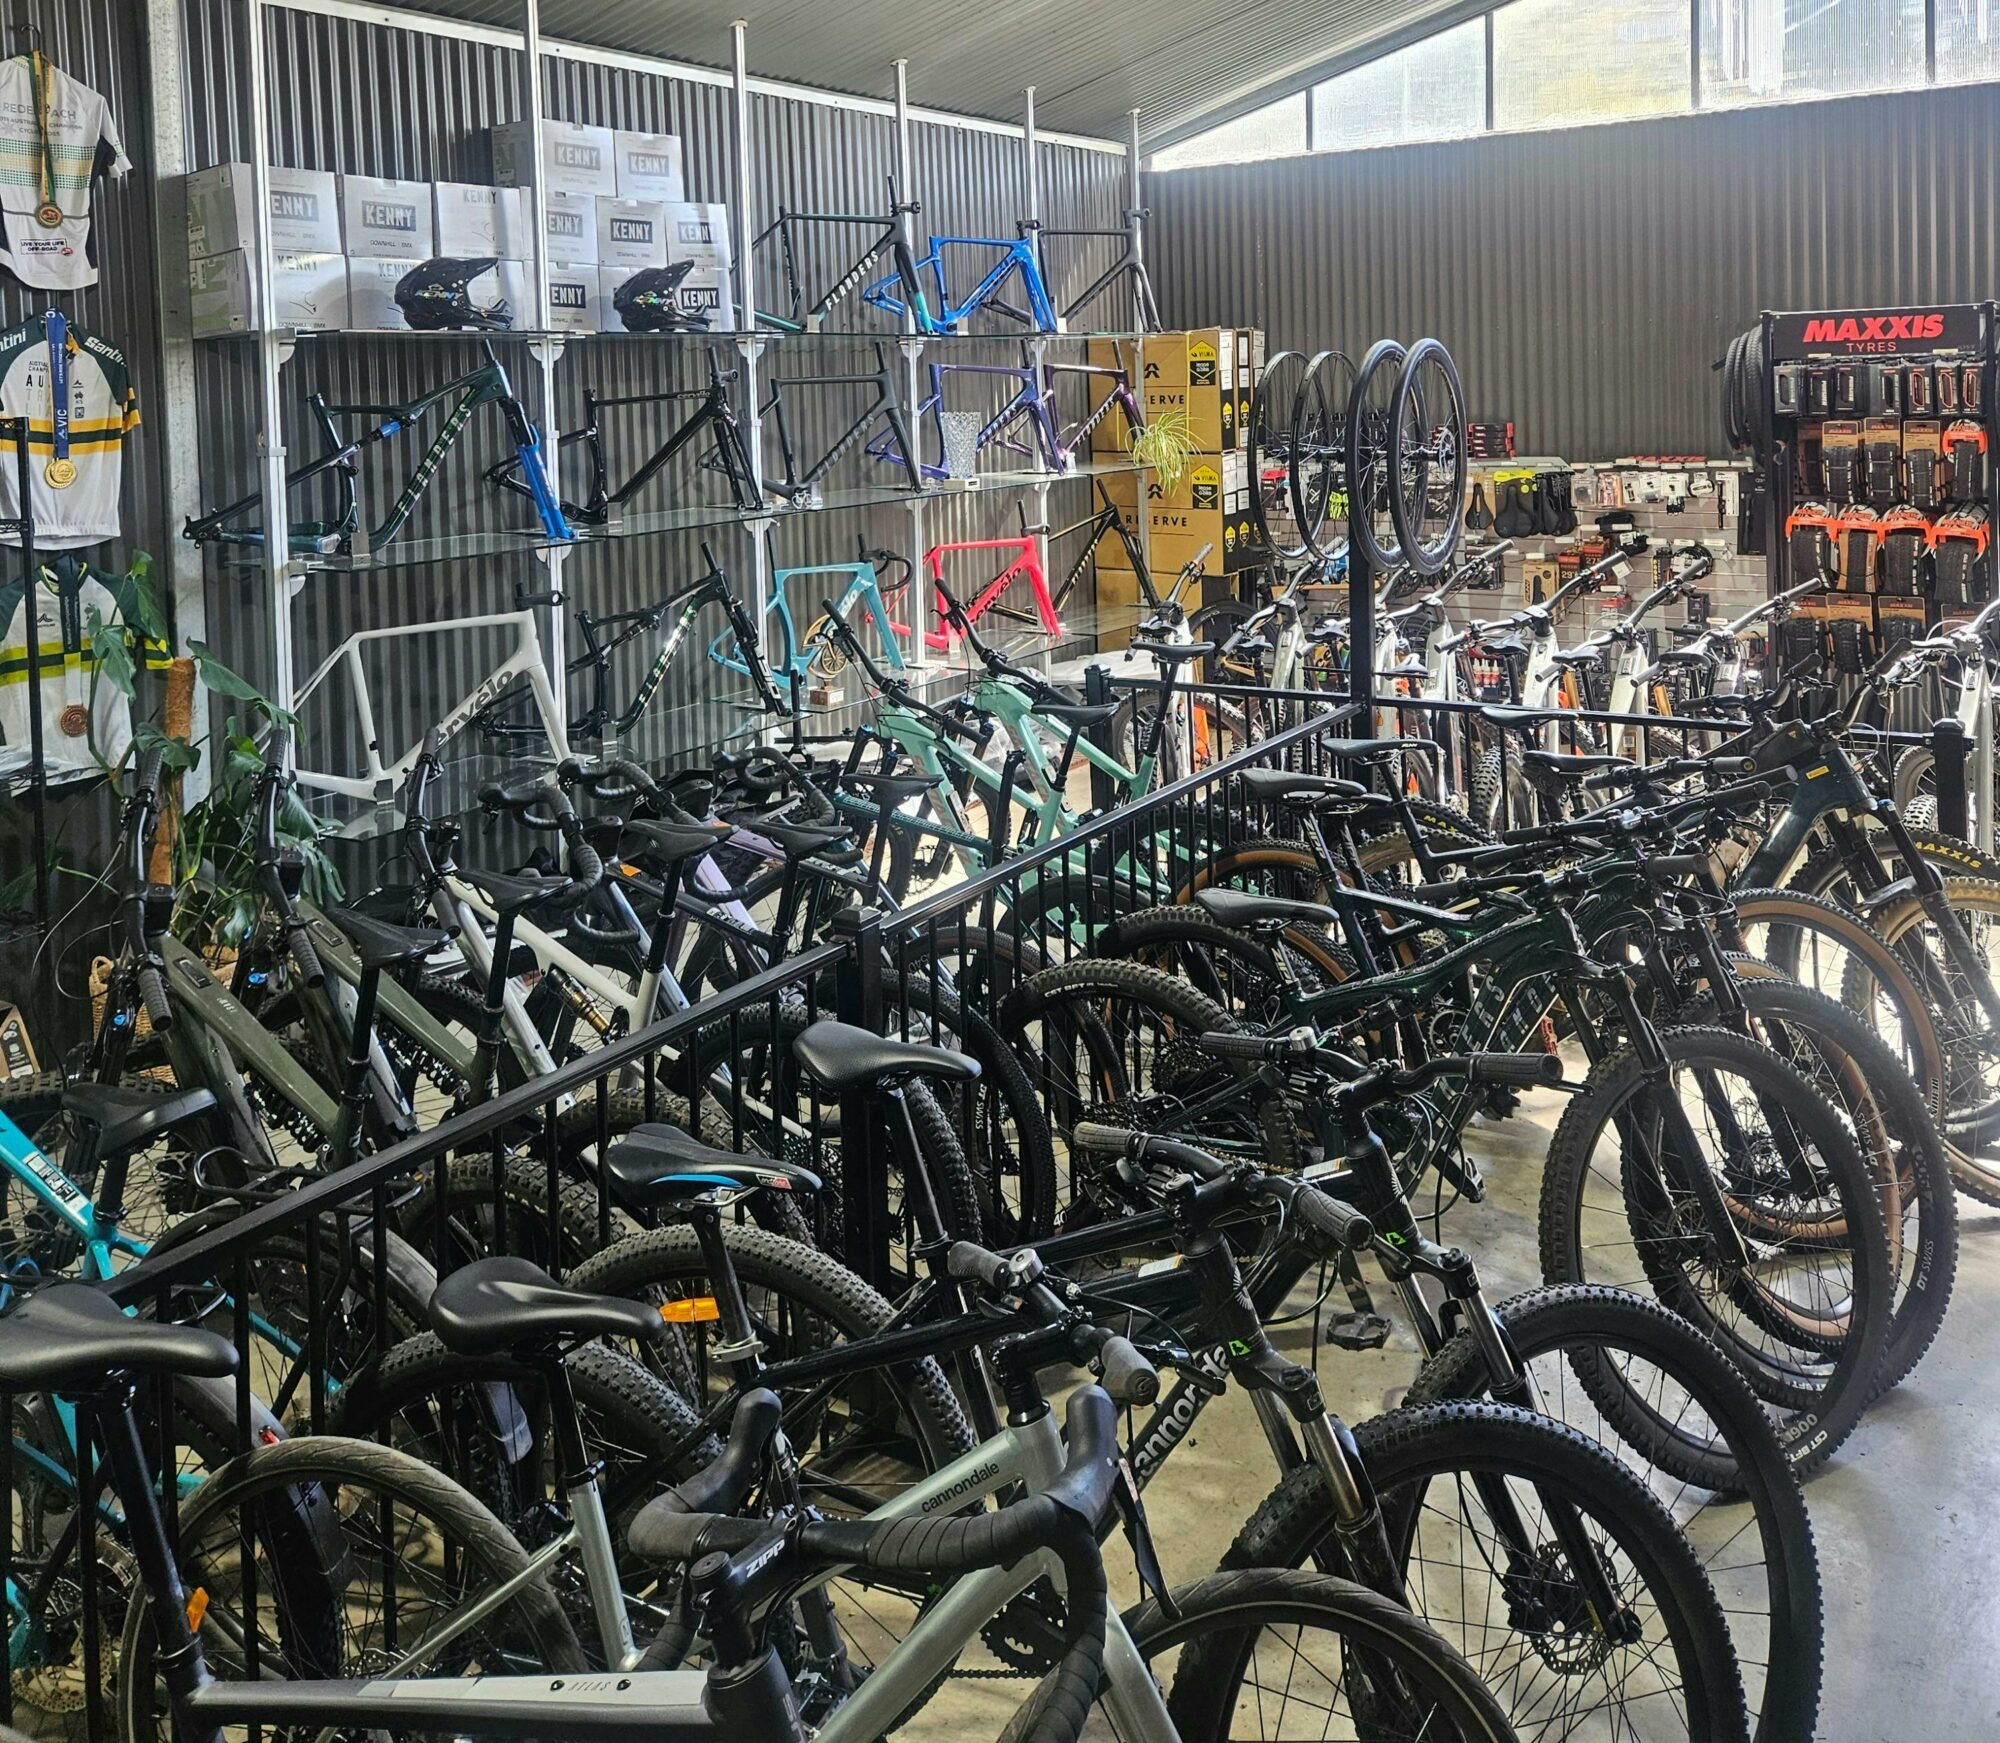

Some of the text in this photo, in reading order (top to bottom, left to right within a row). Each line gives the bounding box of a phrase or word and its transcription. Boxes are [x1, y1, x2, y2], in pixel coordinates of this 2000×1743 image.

[557, 146, 598, 167] KENNY
[630, 154, 667, 174] KENNY
[270, 194, 313, 217] ENNY
[365, 205, 412, 228] KENNY
[548, 214, 579, 234] ENNY
[612, 221, 650, 240] KENNY
[824, 250, 879, 311] FLANDERS
[551, 285, 583, 308] ENNY
[683, 289, 717, 308] KENNY
[1803, 314, 1944, 343] MAXXIS
[1846, 342, 1897, 353] TYRES
[1150, 394, 1185, 405] ERVE
[817, 412, 875, 478] FLANDERS
[397, 402, 472, 517] FLANDERS
[1126, 514, 1188, 527] RERVE
[971, 567, 1021, 622] ervélo
[436, 670, 513, 747] ervélo
[1916, 1239, 1935, 1292] DT SWISS
[1134, 1344, 1231, 1482] annonda
[921, 1462, 1000, 1513] cannondale
[746, 1538, 786, 1578] ZIPP
